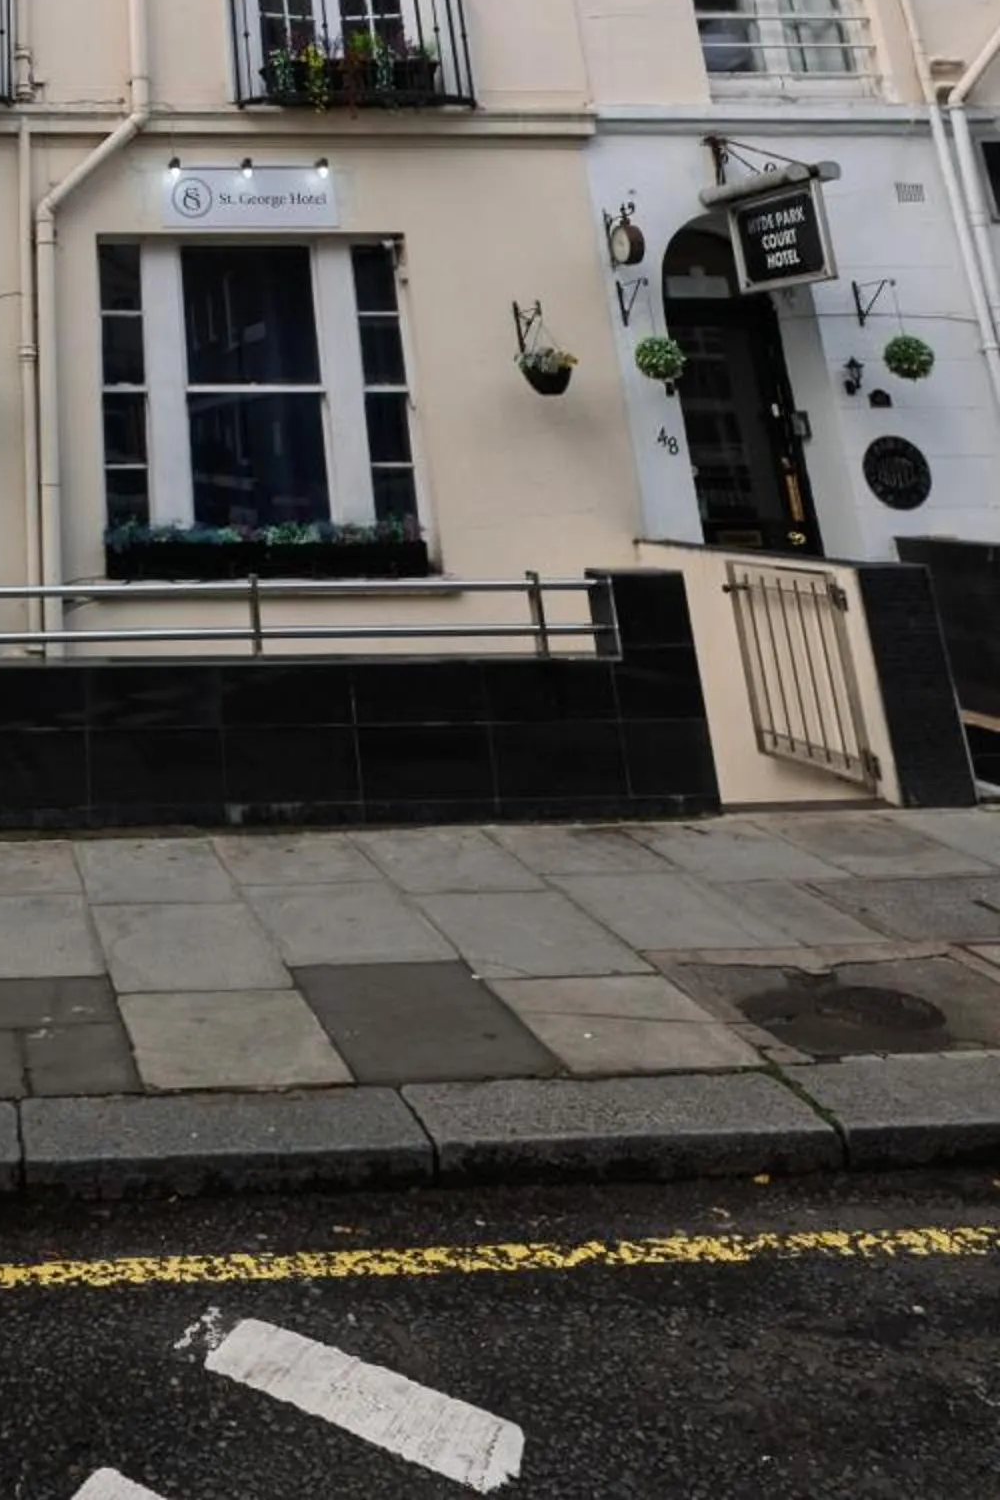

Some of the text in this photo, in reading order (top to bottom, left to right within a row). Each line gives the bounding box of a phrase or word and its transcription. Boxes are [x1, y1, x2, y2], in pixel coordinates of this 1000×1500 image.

[218, 191, 327, 209] St. George Hotel
[775, 206, 805, 227] PARK
[762, 229, 797, 250] COURT
[766, 249, 800, 268] HOTEL
[657, 426, 679, 455] 48
